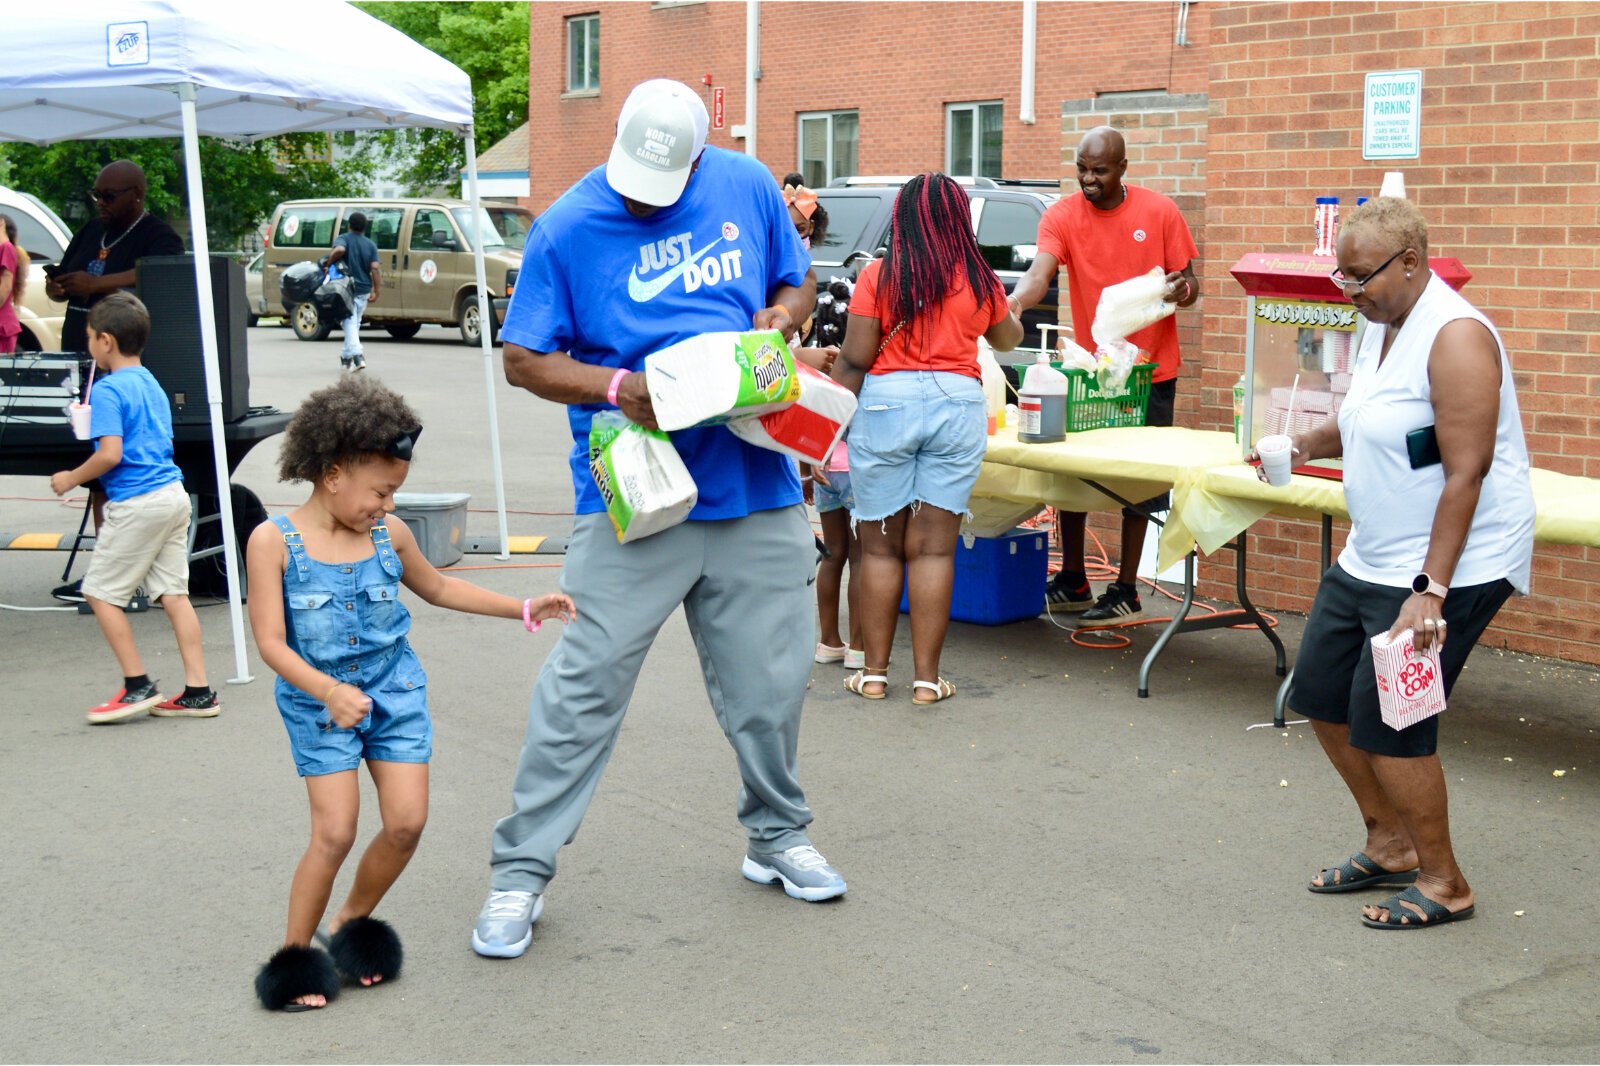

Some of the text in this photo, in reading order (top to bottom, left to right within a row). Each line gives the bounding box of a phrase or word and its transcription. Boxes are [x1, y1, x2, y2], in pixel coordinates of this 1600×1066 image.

[1371, 82, 1415, 97] CUSTOMER
[715, 90, 723, 127] FDC
[1374, 100, 1410, 115] PARKING
[644, 127, 677, 148] NORTH
[636, 147, 671, 168] CAROLINA
[638, 231, 692, 275] JUST
[753, 350, 788, 392] Bounty
[1400, 661, 1424, 685] POP
[1405, 667, 1434, 697] CORN
